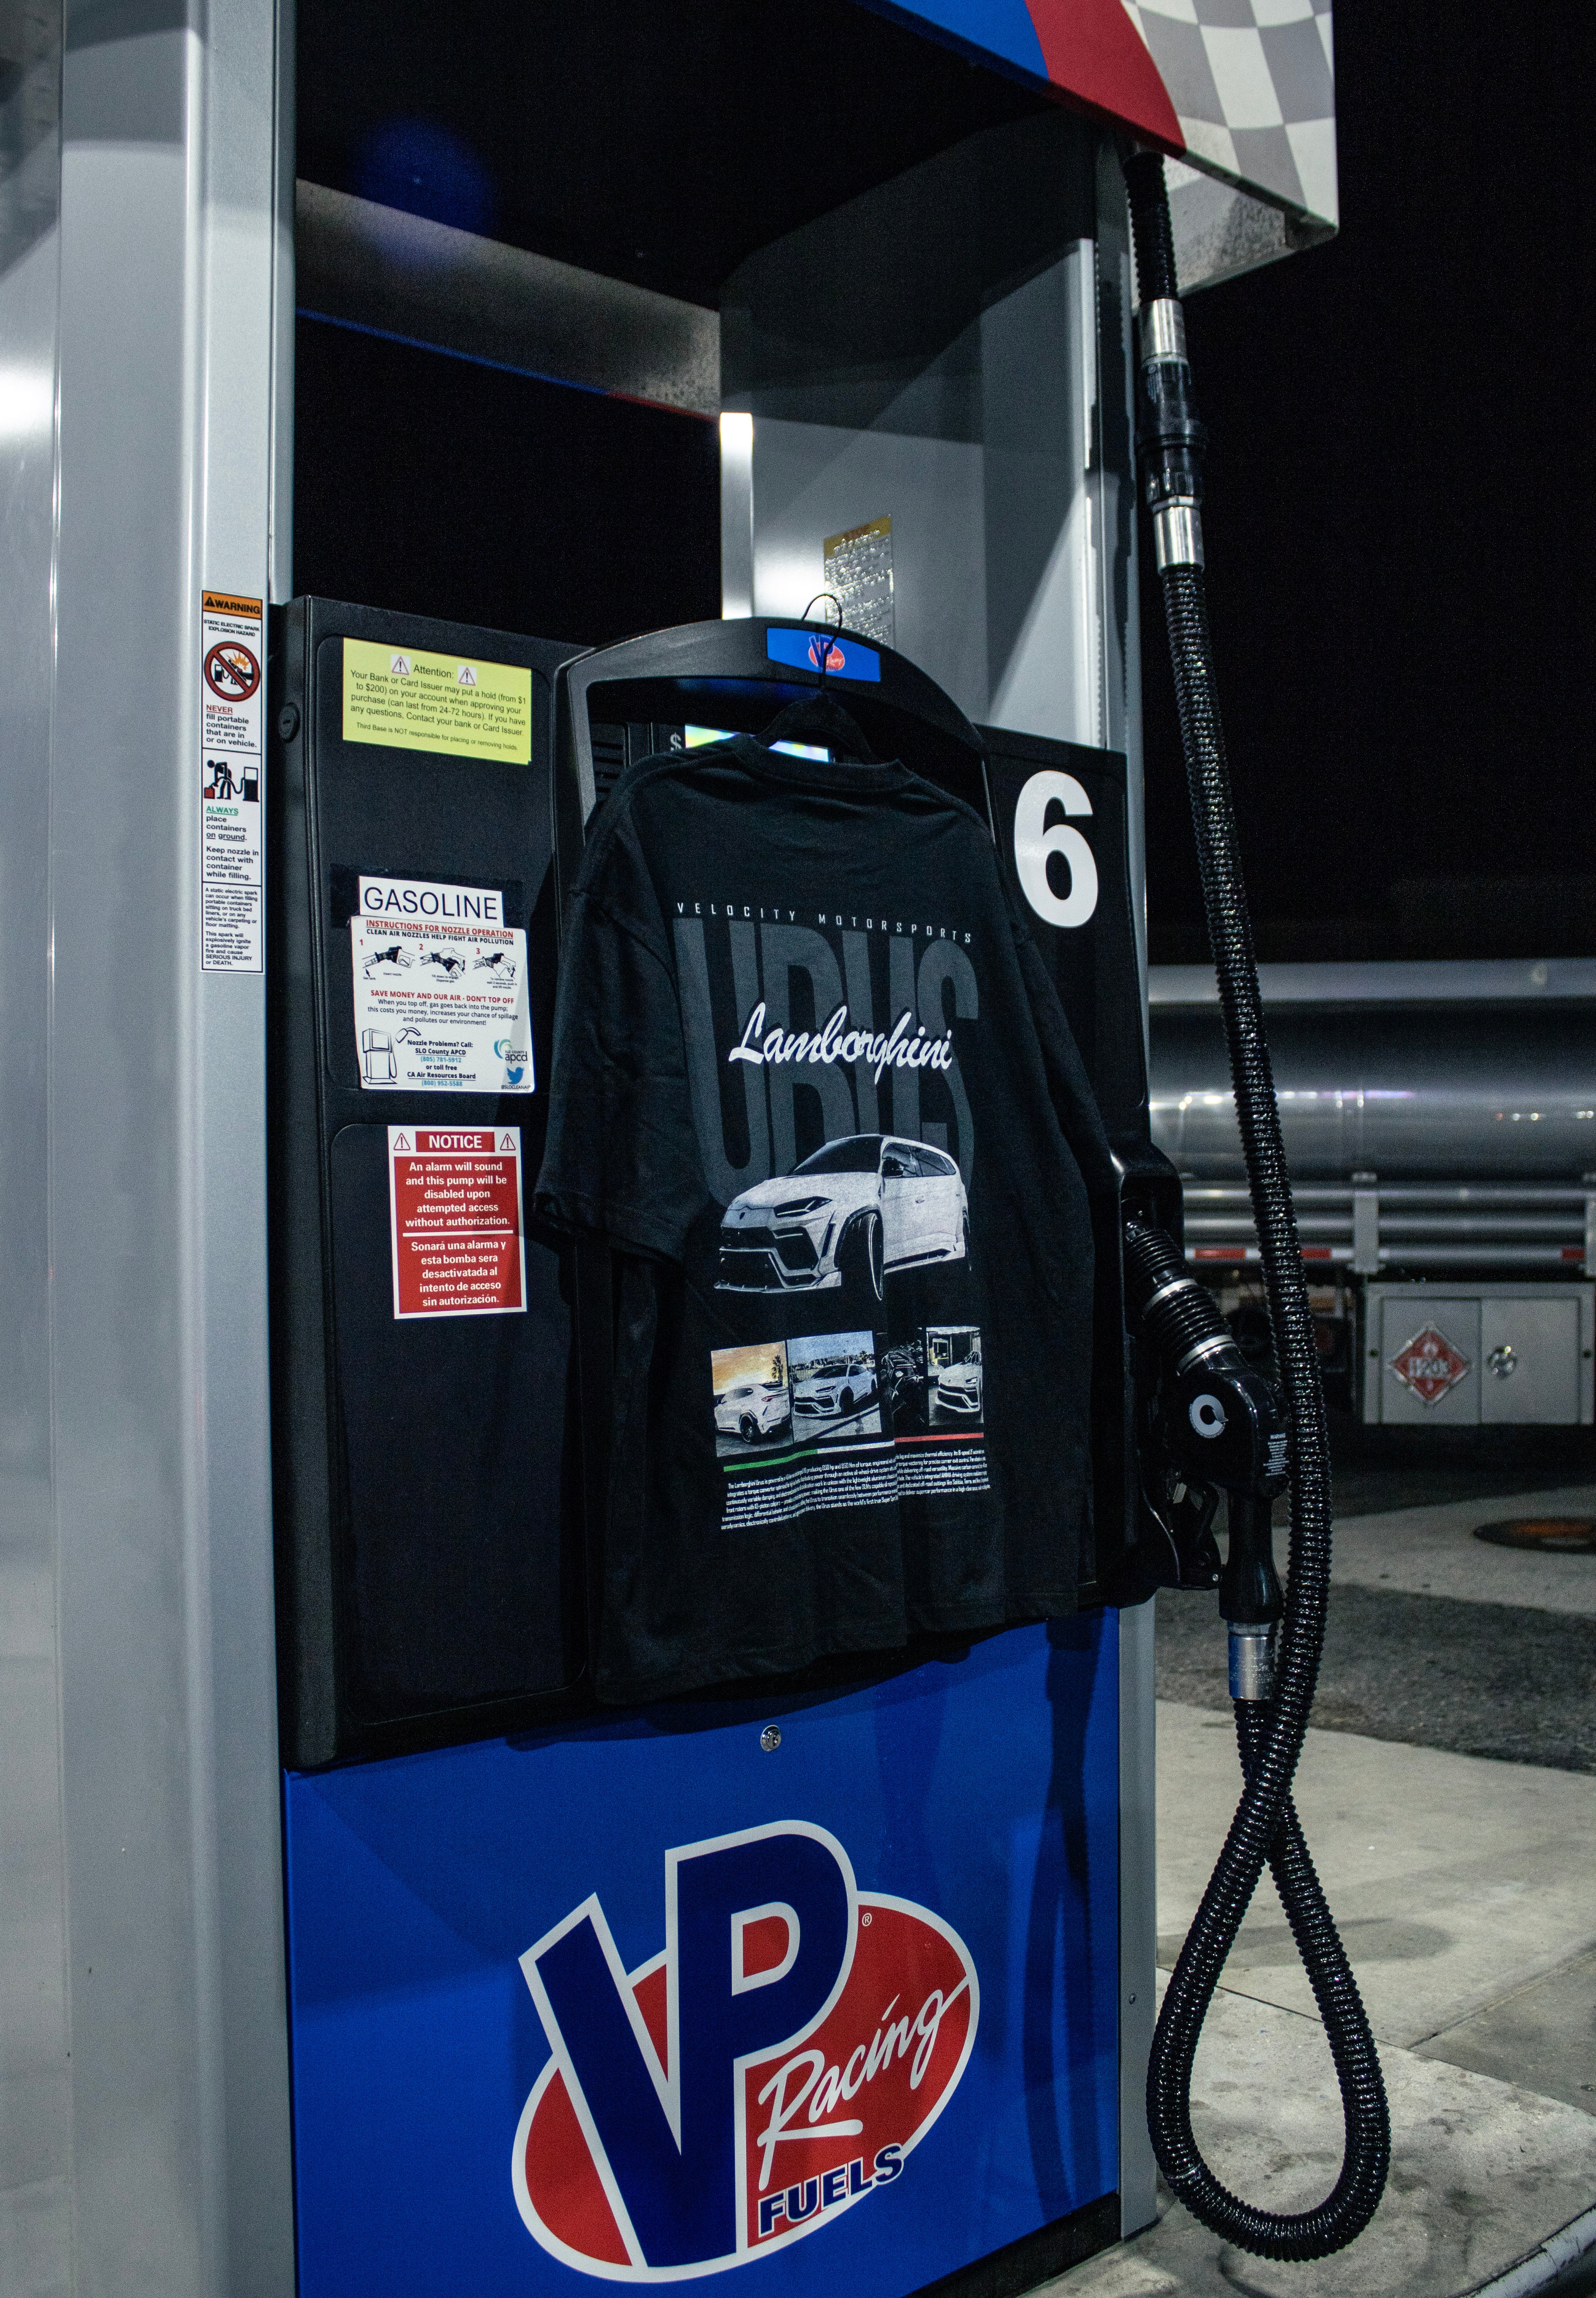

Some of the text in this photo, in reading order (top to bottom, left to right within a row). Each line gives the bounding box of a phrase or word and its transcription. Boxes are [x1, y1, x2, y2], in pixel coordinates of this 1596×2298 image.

[215, 599, 260, 614] WARNING
[413, 664, 453, 678] Attention:
[350, 669, 367, 679] Your
[370, 672, 389, 683] Bank
[401, 677, 418, 687] Card
[421, 681, 442, 691] Issuer
[444, 686, 460, 695] may
[481, 690, 496, 699] hold
[498, 693, 516, 703] (from
[518, 696, 525, 704] $1
[365, 683, 387, 695] $200)
[419, 693, 447, 703] account
[449, 697, 468, 706] when
[470, 701, 504, 713] approving
[206, 704, 233, 714] NEVER
[351, 694, 385, 705] purchase
[388, 698, 404, 707] (can
[406, 701, 419, 709] last
[421, 703, 437, 712] from
[439, 705, 460, 716] 24-72
[509, 716, 525, 725] have
[206, 722, 246, 731] containers
[350, 705, 364, 714] any
[406, 711, 435, 723] Contact
[454, 719, 471, 728] bank
[482, 723, 499, 732] Card
[502, 726, 523, 735] Issuer.
[206, 806, 238, 814] ALWAYS
[1014, 770, 1098, 928] 6
[364, 886, 497, 920] GASOLINE
[366, 920, 423, 931] INSTRUCTIONS
[441, 926, 470, 935] NOZZLE
[472, 928, 513, 938] OPERATION
[678, 902, 971, 943] VELOCITY MOTORSPORTS
[729, 1002, 952, 1084] Lamborghini
[505, 1051, 527, 1064] apcd
[429, 1135, 482, 1149] NOTICE
[409, 1162, 502, 1171] An alarm will sound
[406, 1175, 507, 1187] and this pump will be
[424, 1189, 490, 1200] disabled upon
[417, 1203, 466, 1214] attempted
[405, 1216, 510, 1227] without authorization.
[411, 1241, 445, 1251] Sonará
[467, 1240, 498, 1249] alarma
[500, 1242, 506, 1250] y
[421, 1256, 442, 1265] esta
[443, 1254, 476, 1264] bomba
[422, 1267, 497, 1278] desactivatada al
[420, 1283, 455, 1292] intento
[456, 1281, 468, 1291] de
[423, 1294, 499, 1306] sin autorización.
[519, 1819, 857, 2268] VP
[757, 1990, 968, 2190] Racing
[758, 2143, 905, 2239] FUELS
